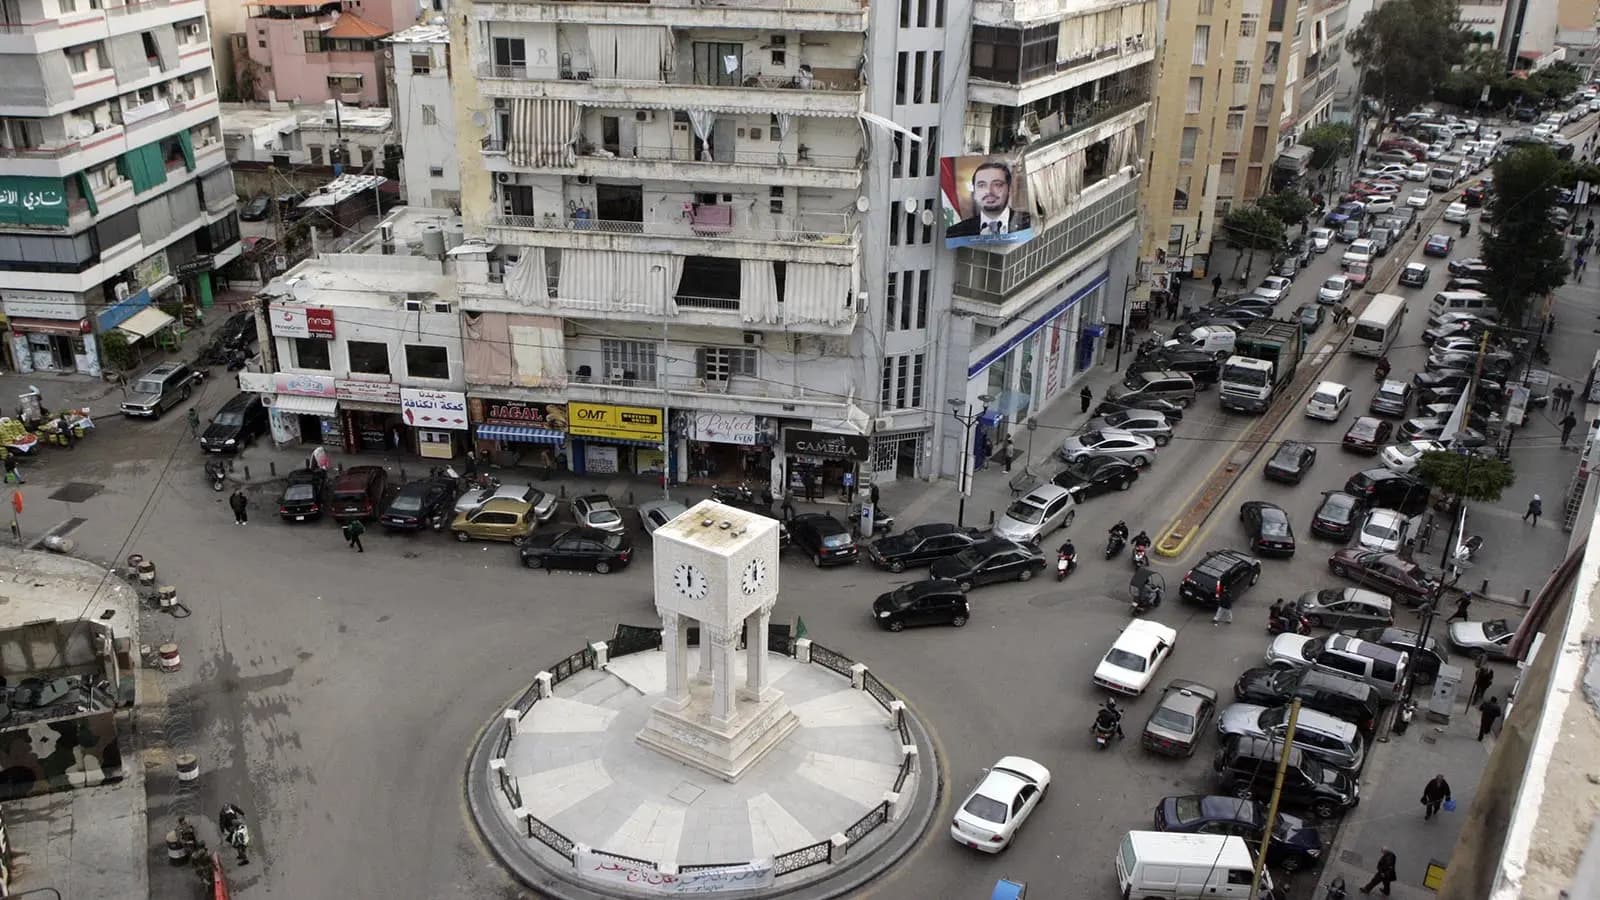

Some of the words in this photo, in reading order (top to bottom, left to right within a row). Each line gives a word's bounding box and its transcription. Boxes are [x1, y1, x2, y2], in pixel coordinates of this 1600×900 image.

[403, 399, 438, 409] الكنافة
[440, 401, 464, 411] كعكة
[577, 409, 608, 420] OMT
